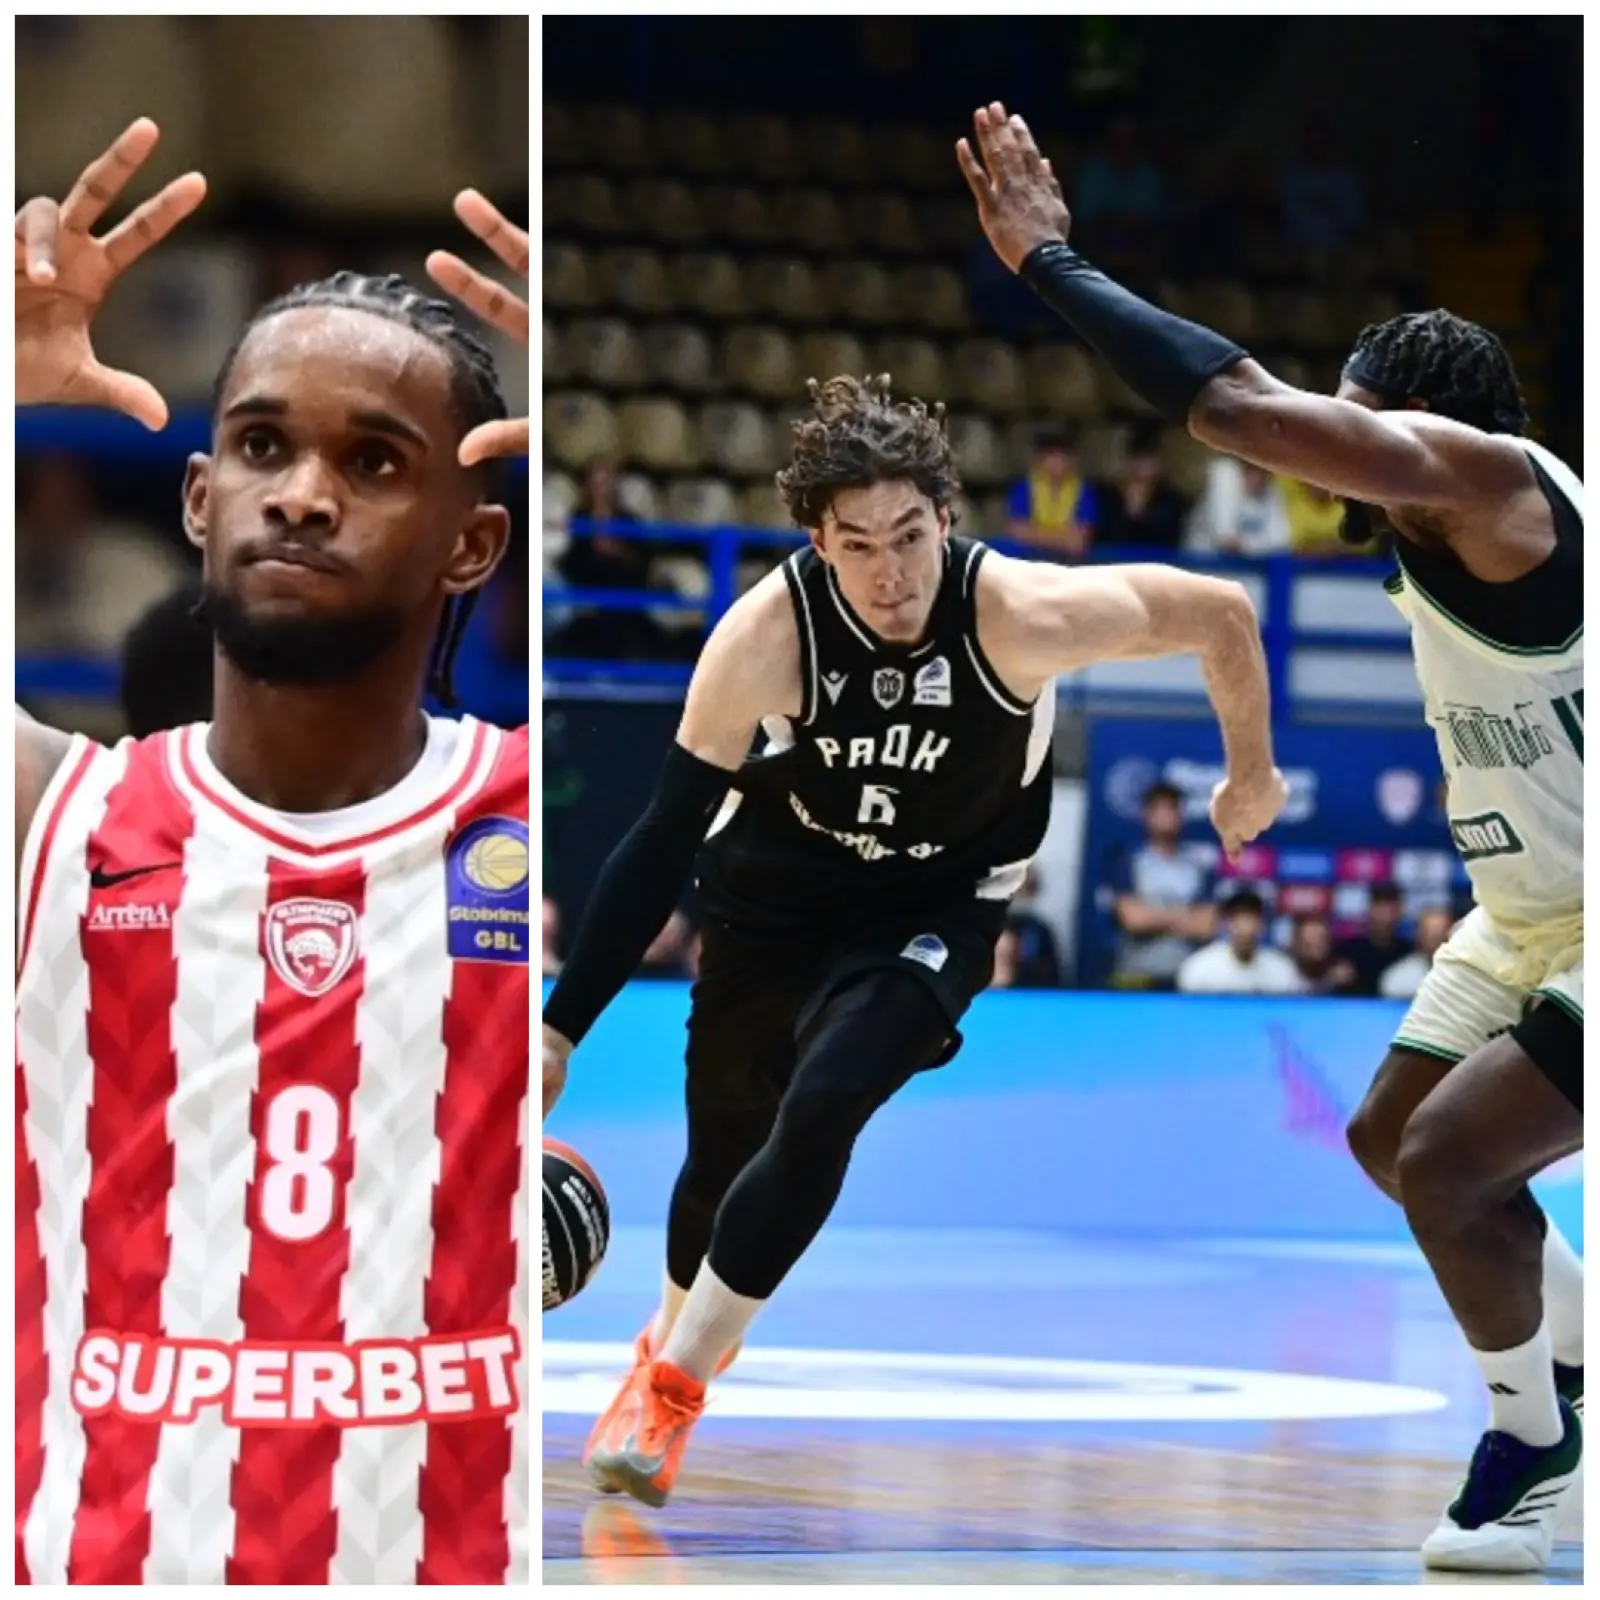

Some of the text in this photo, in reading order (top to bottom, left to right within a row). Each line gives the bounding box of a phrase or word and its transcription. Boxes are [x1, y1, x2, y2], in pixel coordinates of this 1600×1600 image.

[814, 724, 951, 773] PAOK
[857, 784, 900, 826] 6
[474, 929, 522, 951] GBL
[260, 1084, 340, 1241] 8
[74, 1334, 514, 1419] SUPERBET
